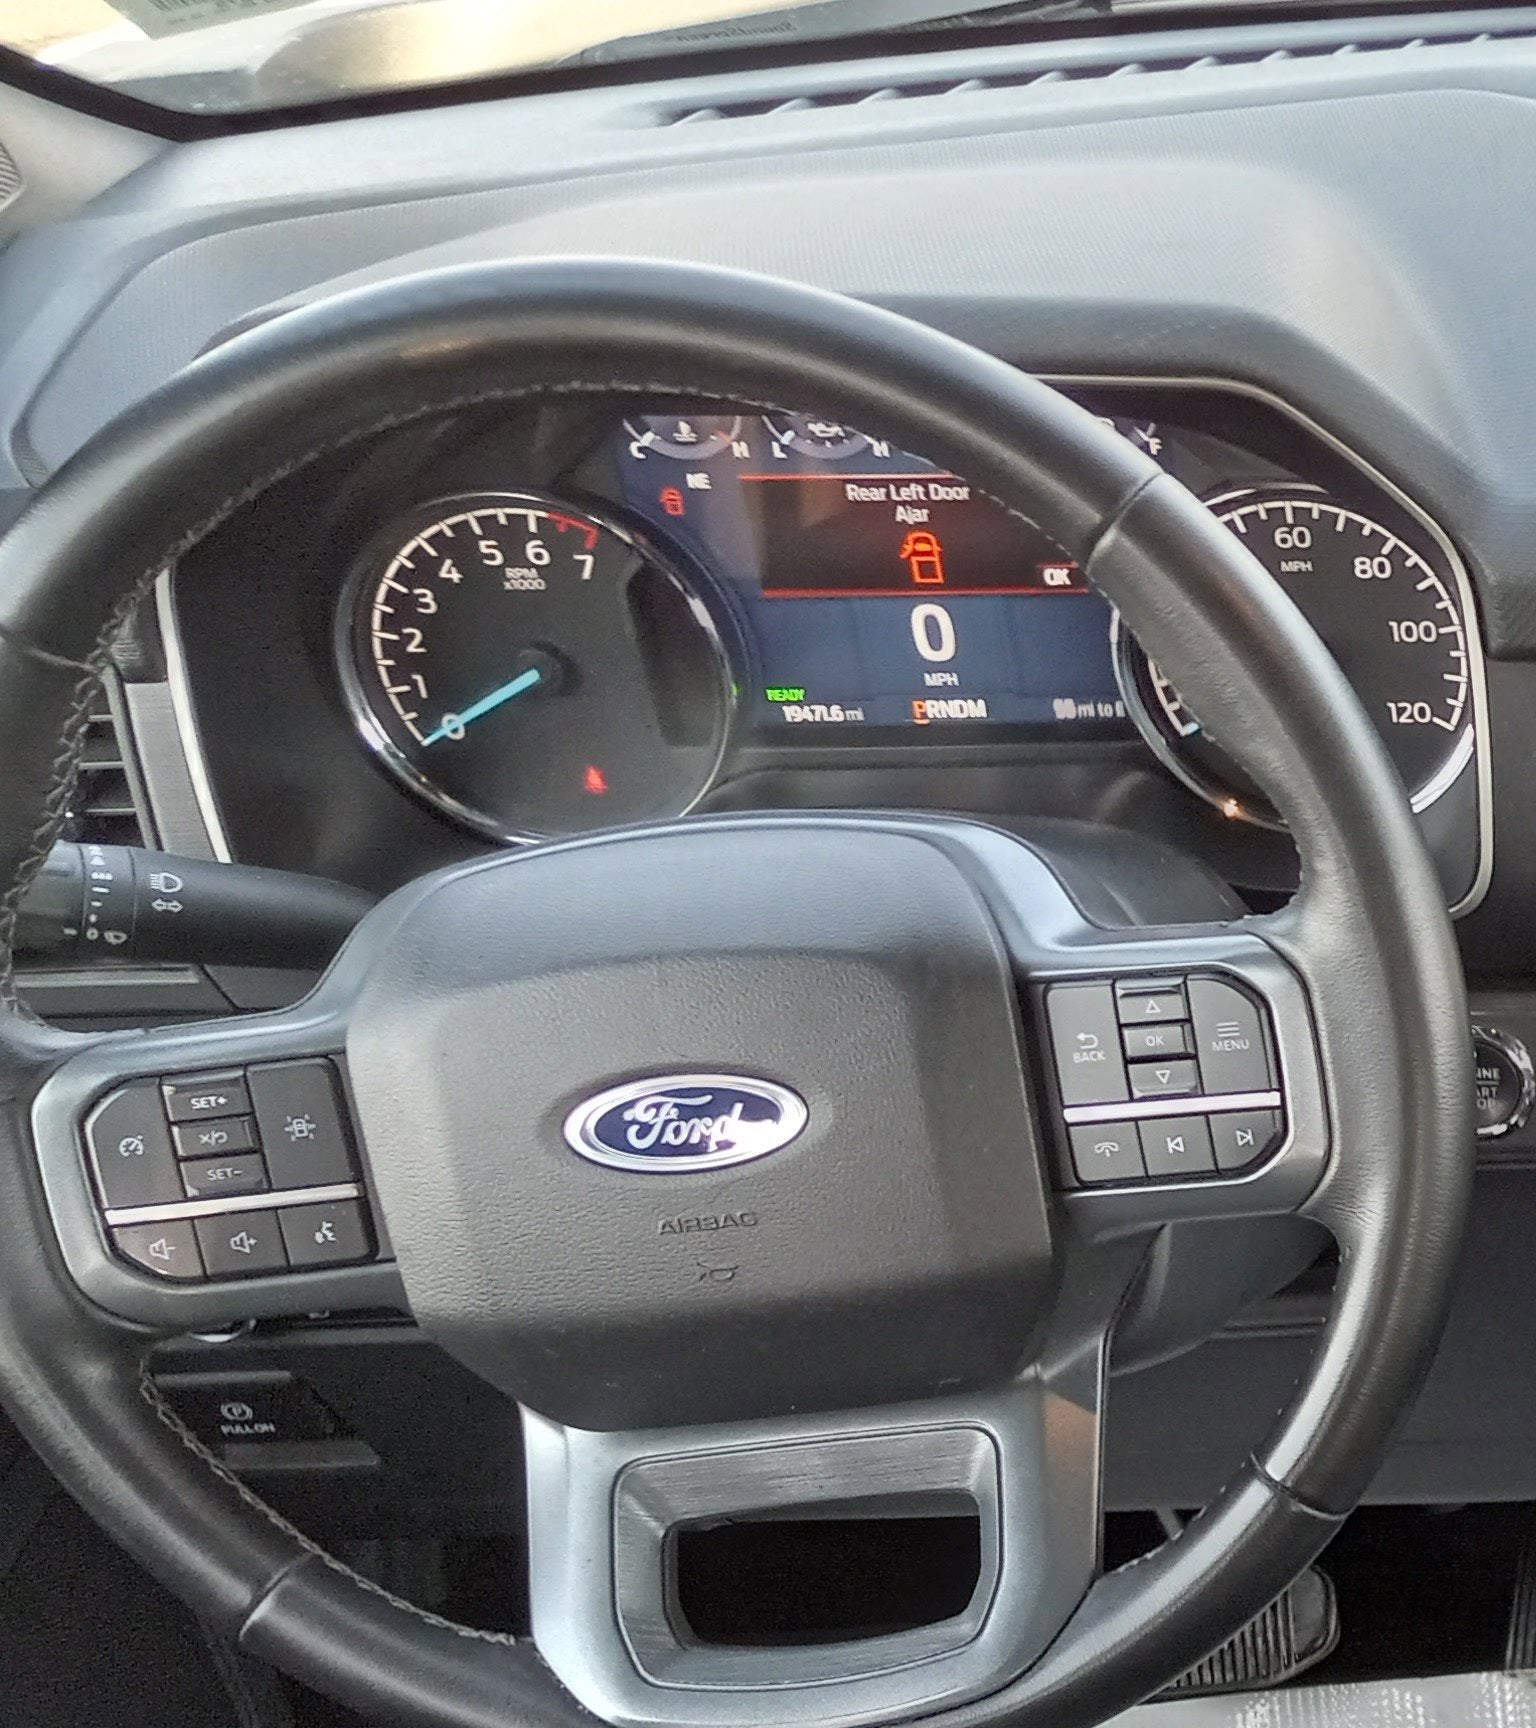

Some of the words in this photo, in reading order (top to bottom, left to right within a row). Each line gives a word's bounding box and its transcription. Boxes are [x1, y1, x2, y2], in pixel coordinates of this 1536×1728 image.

[629, 441, 647, 459] C
[772, 441, 788, 459] L
[686, 473, 712, 490] NE
[846, 484, 888, 502] Rear
[890, 484, 927, 501] Left
[929, 483, 971, 501] Door
[895, 505, 931, 525] Ajar
[1274, 526, 1312, 548] 60
[478, 540, 504, 566] 5
[526, 540, 551, 566] 6
[438, 558, 464, 584] 4
[504, 567, 540, 579] RPM
[573, 554, 595, 580] 7
[1043, 566, 1072, 586] OK
[1280, 560, 1313, 572] MPH
[1353, 556, 1392, 580] 80
[413, 588, 438, 614] 3
[402, 628, 428, 652] 2
[910, 603, 957, 662] 0
[1388, 620, 1438, 643] 100
[411, 674, 428, 698] 1
[924, 672, 959, 687] MPH
[766, 688, 806, 702] READY
[845, 707, 864, 722] mi
[912, 699, 987, 720] PRNDM
[1386, 701, 1432, 724] 120
[441, 712, 466, 740] 0
[1145, 1034, 1165, 1048] OK
[1212, 1038, 1250, 1053] MENU
[1073, 1049, 1106, 1064] BACK
[622, 1094, 752, 1152] Ford
[658, 1210, 758, 1236] AIRBAG
